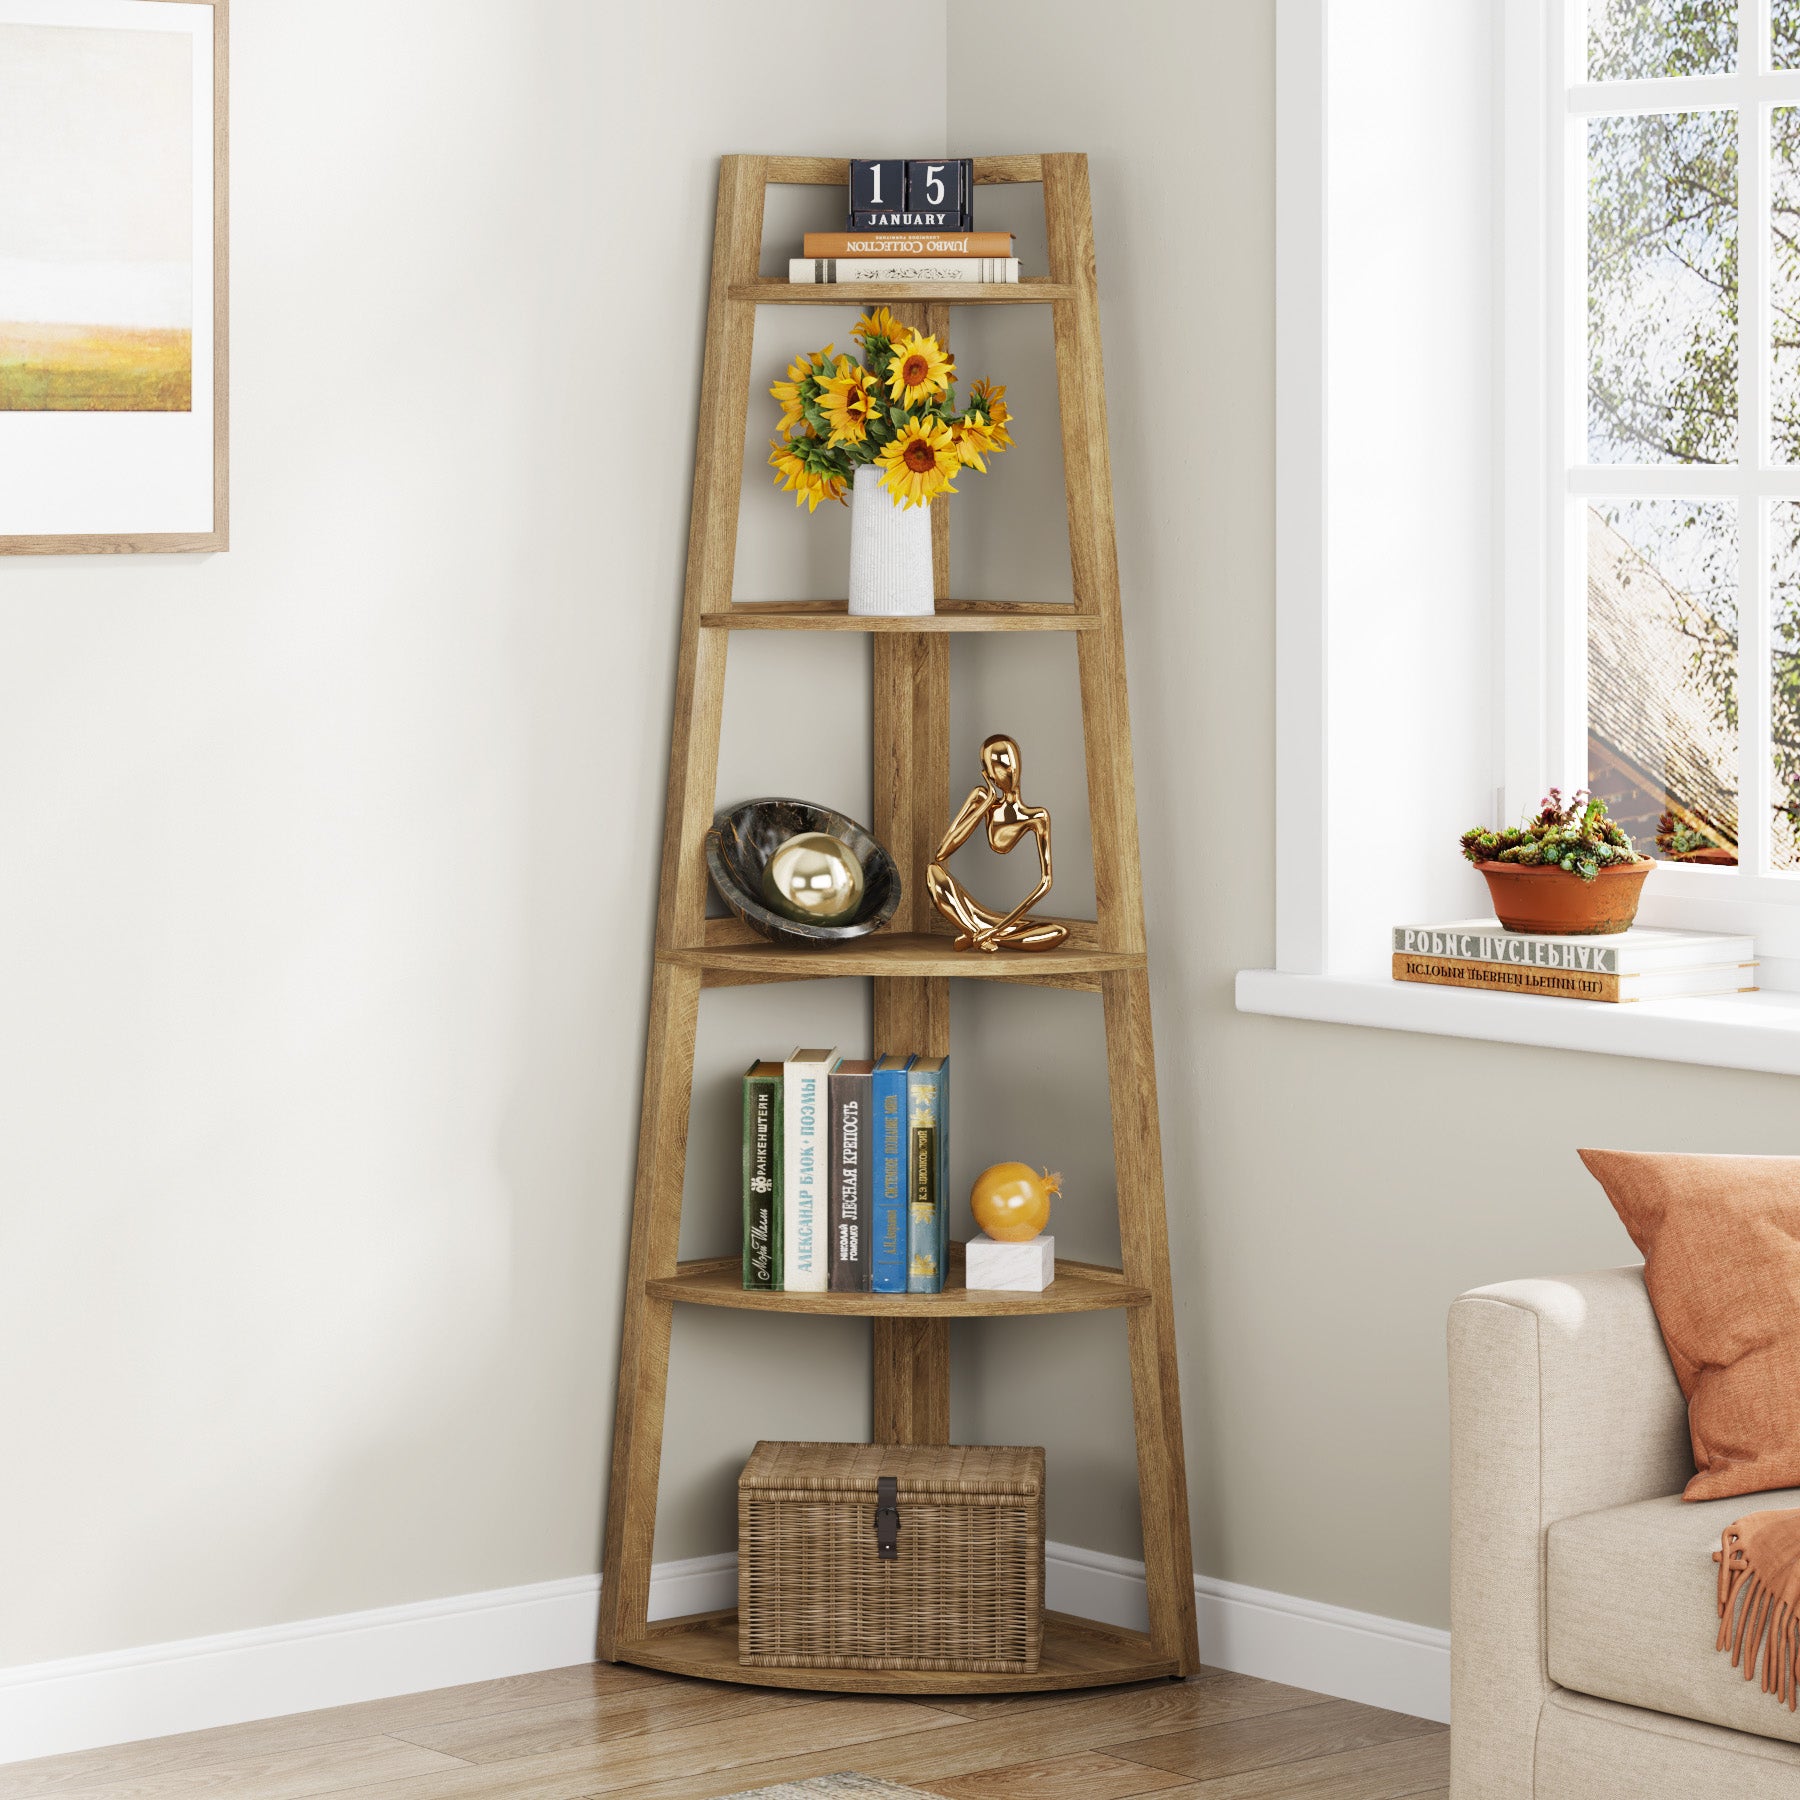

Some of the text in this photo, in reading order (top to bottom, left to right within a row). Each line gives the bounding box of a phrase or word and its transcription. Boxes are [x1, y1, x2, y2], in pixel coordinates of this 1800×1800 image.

[868, 213, 946, 226] JANUARY
[869, 163, 945, 205] 1 5
[798, 1078, 816, 1273] АЛЕКСАНДР БЛОК ПОЭМЫ
[842, 1101, 858, 1220] ЛЕСНАЯ КРЕПОСТЬ
